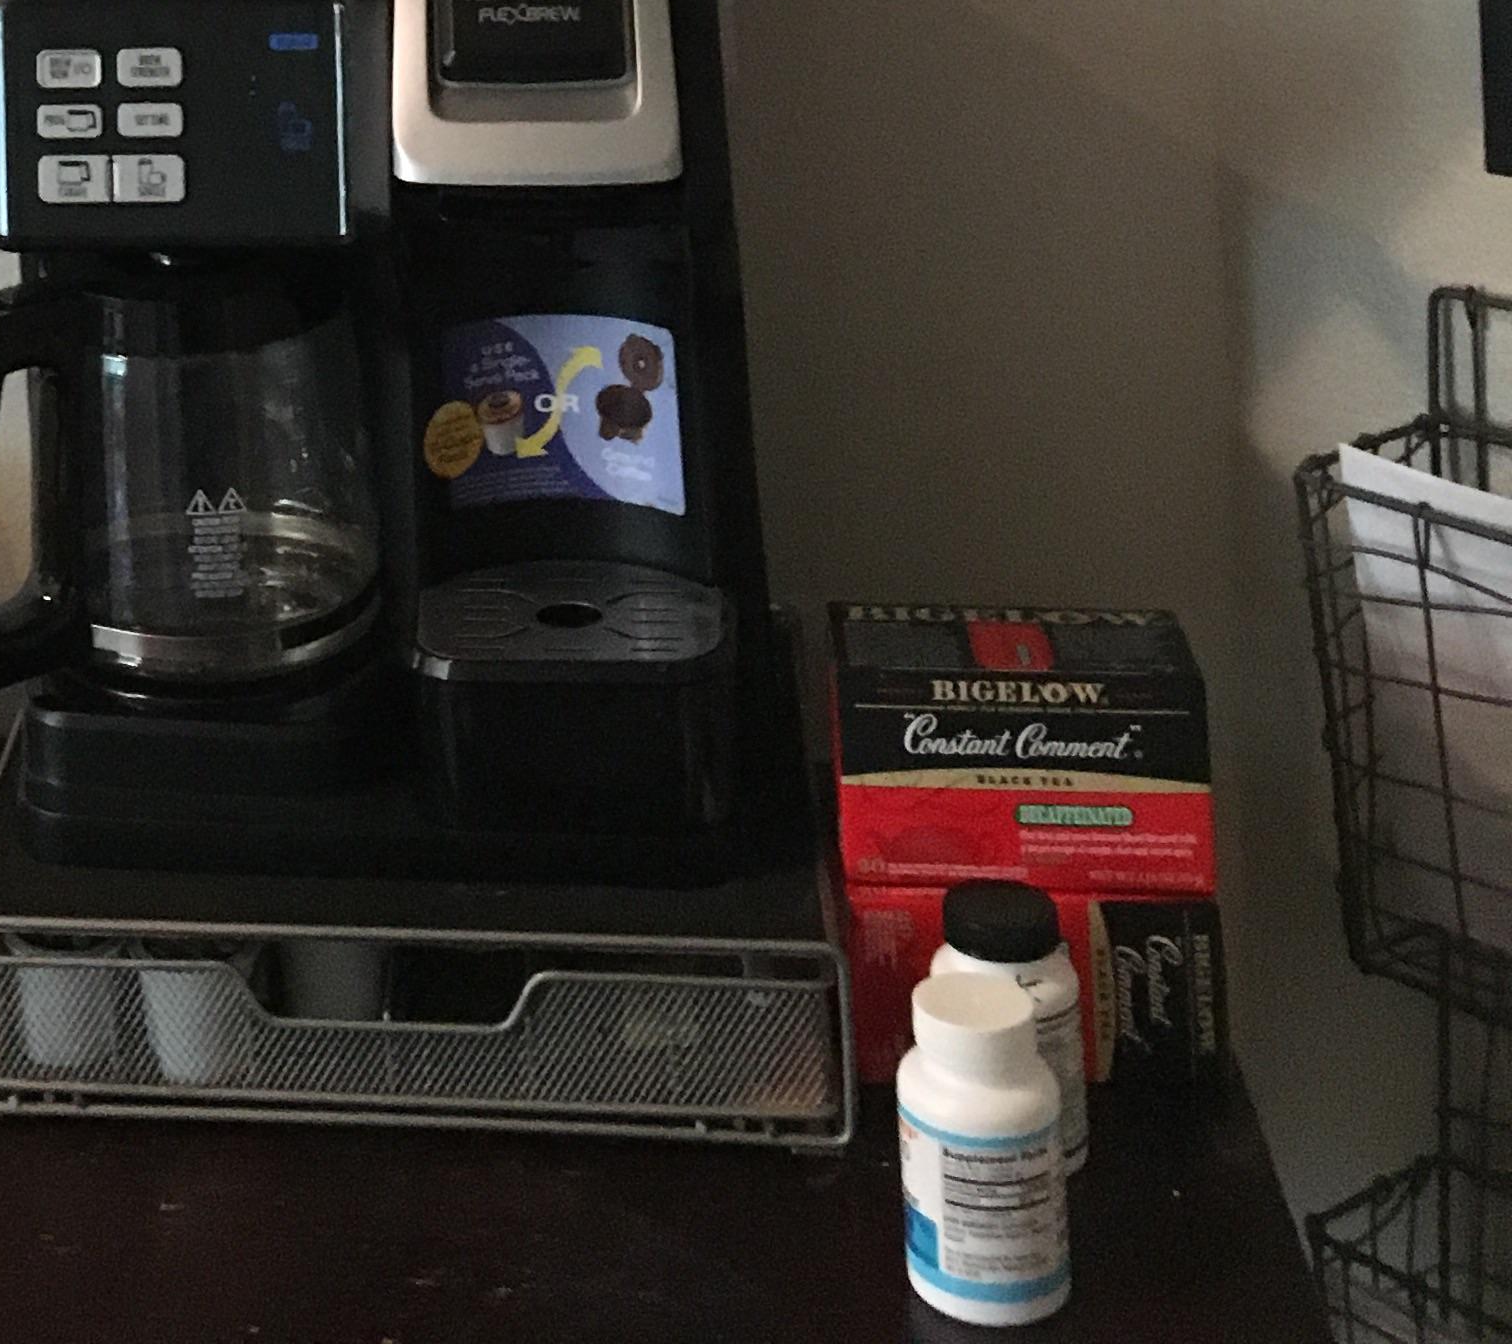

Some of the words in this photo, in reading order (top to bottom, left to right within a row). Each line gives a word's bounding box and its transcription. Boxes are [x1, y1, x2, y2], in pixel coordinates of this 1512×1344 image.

[534, 393, 580, 414] OR
[930, 679, 1105, 704] BIGELOW
[976, 774, 1033, 787] BLACK
[1040, 775, 1074, 787] TEA
